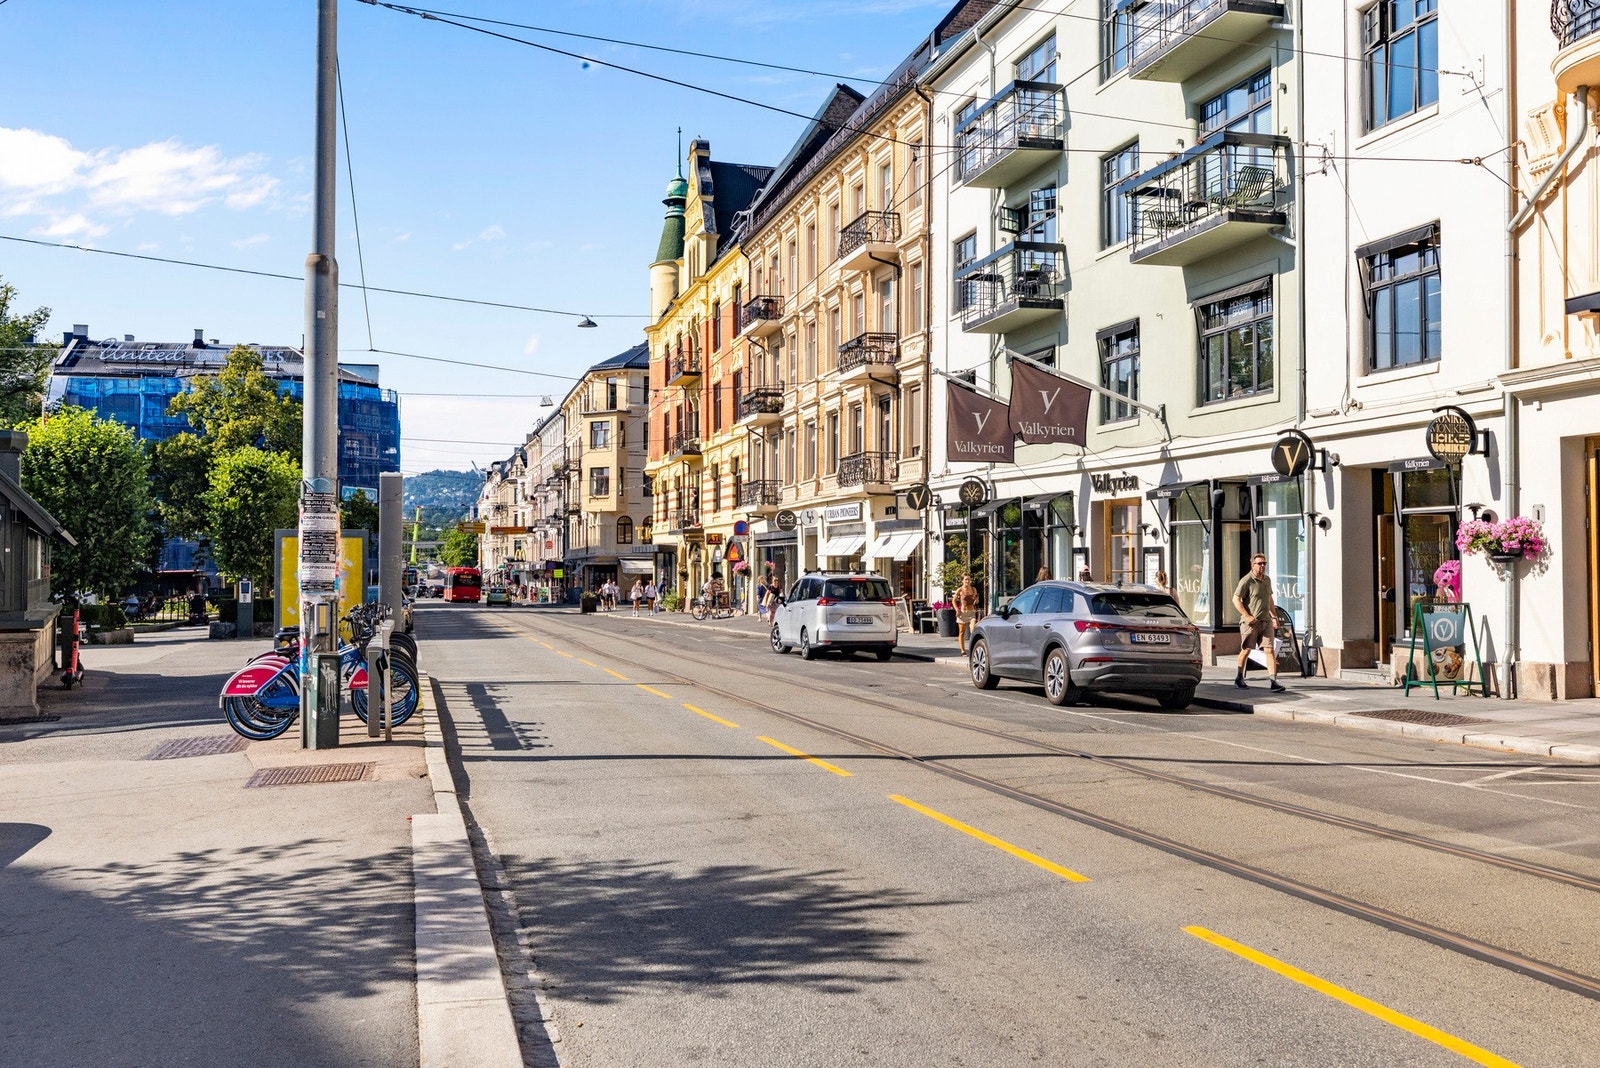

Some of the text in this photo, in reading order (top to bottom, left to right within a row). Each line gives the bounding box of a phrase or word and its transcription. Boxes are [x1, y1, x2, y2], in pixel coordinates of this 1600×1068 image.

[99, 337, 187, 362] United
[1018, 421, 1075, 439] Valkyrien
[954, 440, 1005, 456] Valkyrien
[1091, 471, 1139, 498] Valkyrien
[840, 506, 858, 518] PIONEERS
[1177, 578, 1200, 593] SALG
[1136, 633, 1169, 642] EN 63493
